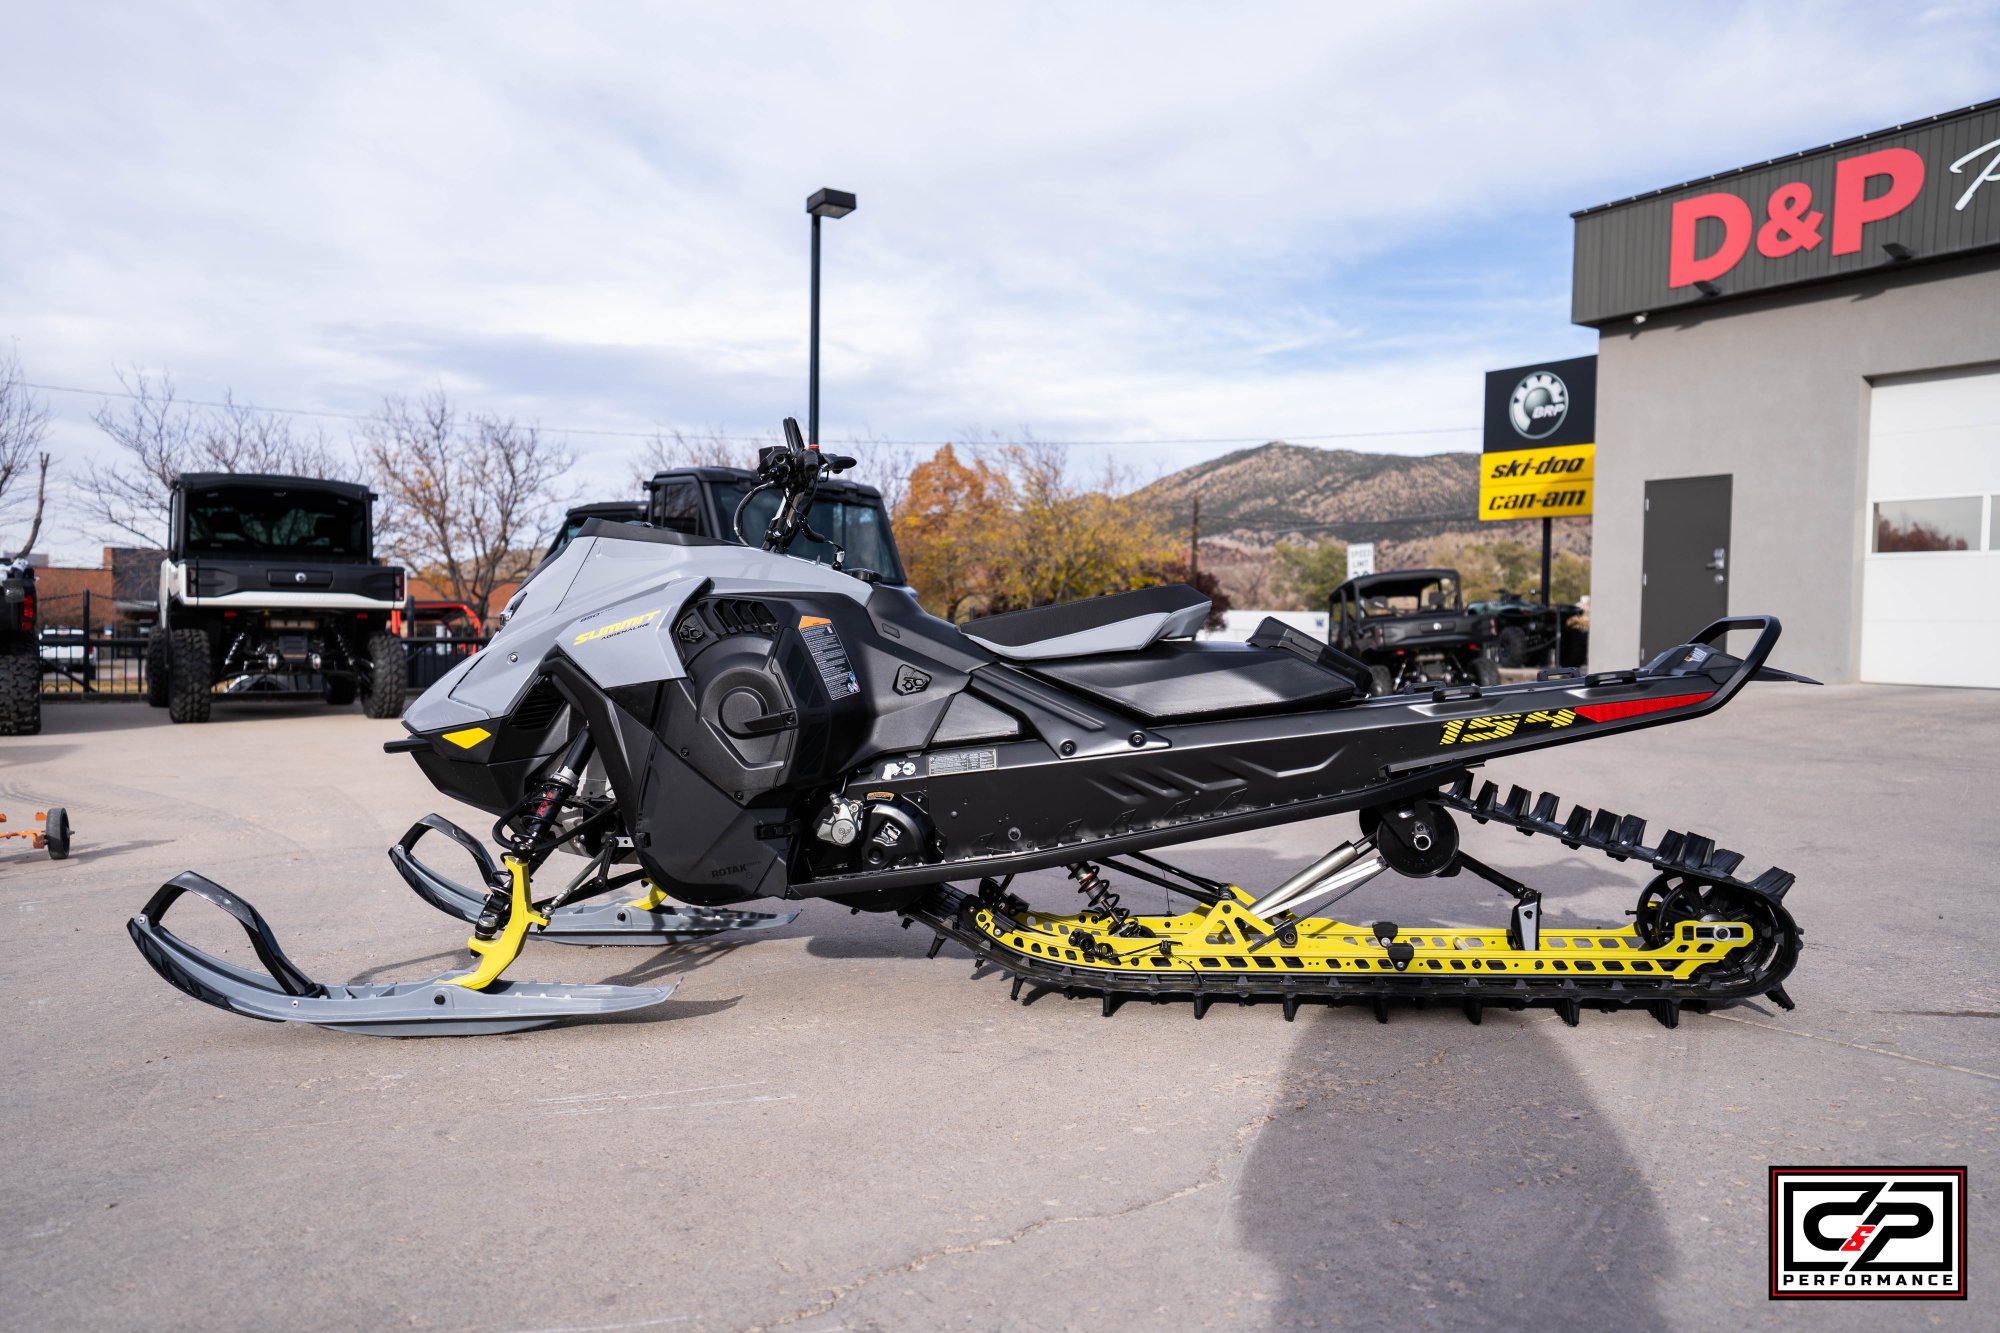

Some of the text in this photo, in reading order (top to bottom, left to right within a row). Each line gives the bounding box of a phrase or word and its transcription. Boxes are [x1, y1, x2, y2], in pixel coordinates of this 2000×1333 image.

[1669, 147, 1925, 288] D&P
[1532, 403, 1566, 419] BRP
[1491, 456, 1585, 479] ski-doo
[1489, 489, 1586, 511] can-am
[573, 609, 661, 646] SUMMIT
[601, 622, 651, 640] ADRENALINE
[1439, 708, 1577, 745] 154
[711, 863, 747, 878] ROTAX
